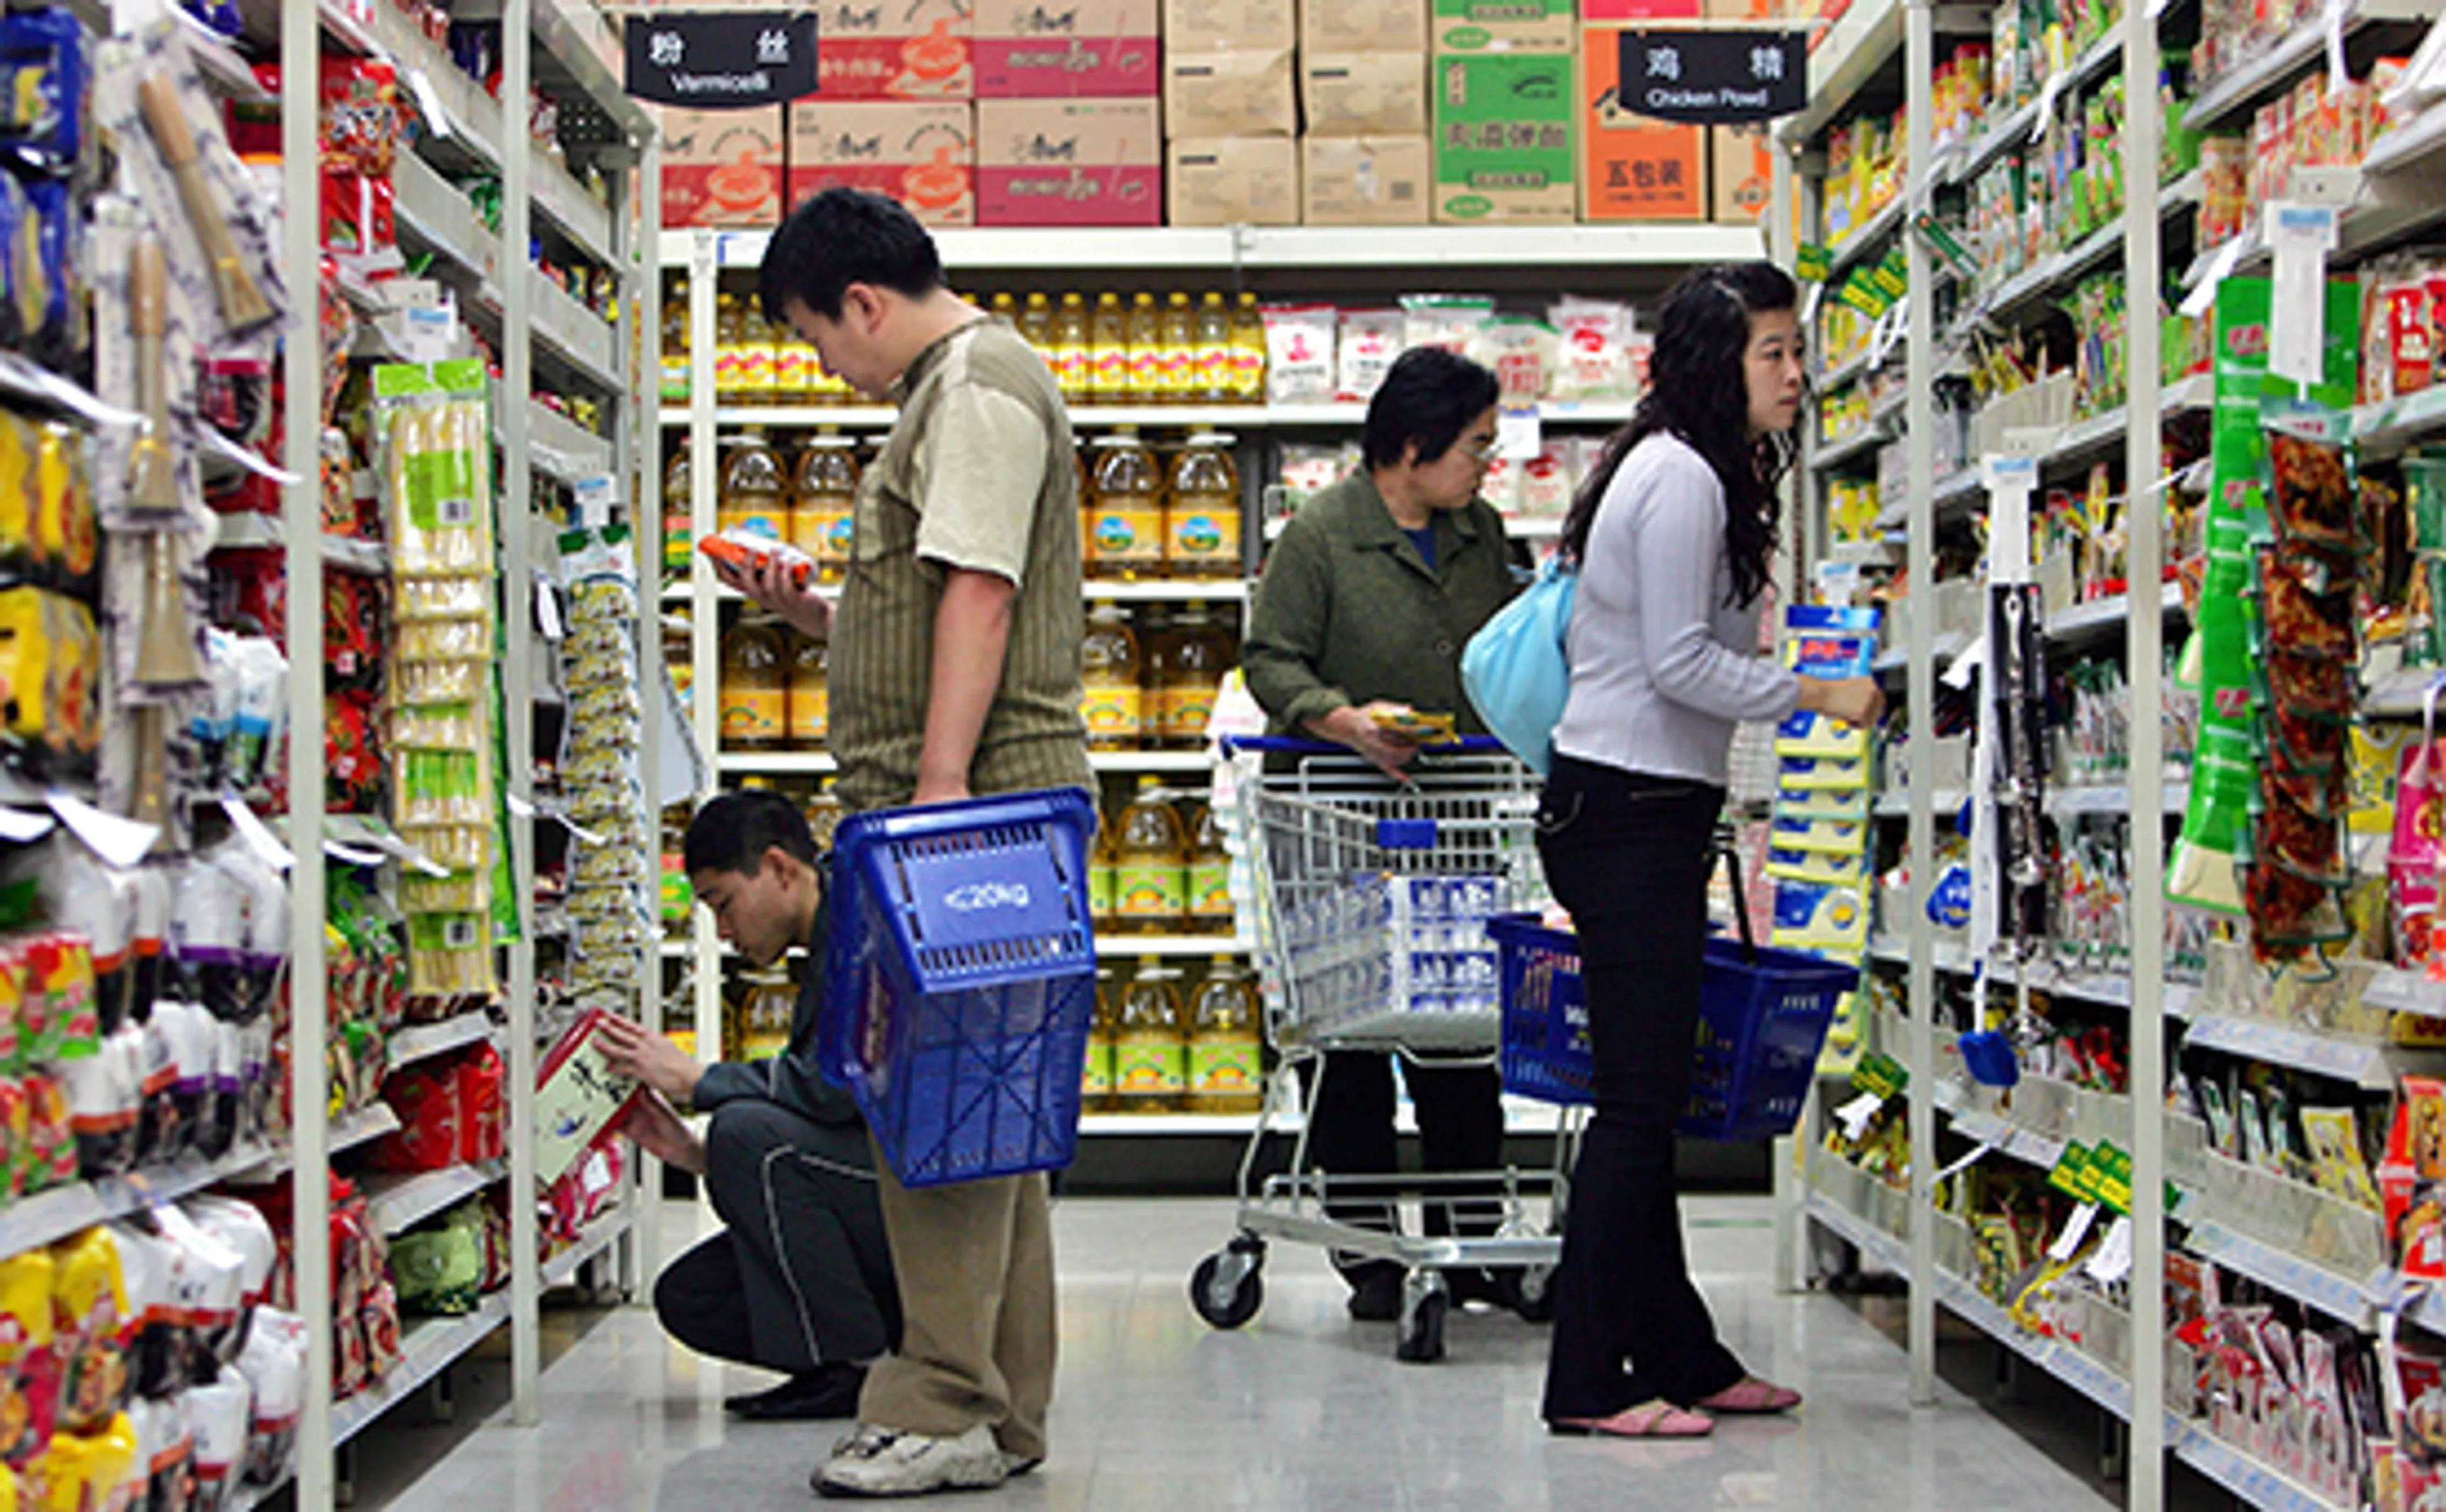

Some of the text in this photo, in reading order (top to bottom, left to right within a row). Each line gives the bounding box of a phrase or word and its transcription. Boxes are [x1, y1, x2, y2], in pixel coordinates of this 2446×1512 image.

[670, 71, 769, 93] Vermicelli
[1645, 87, 1768, 108] Chicken Powd
[1605, 159, 1683, 189] 五包装
